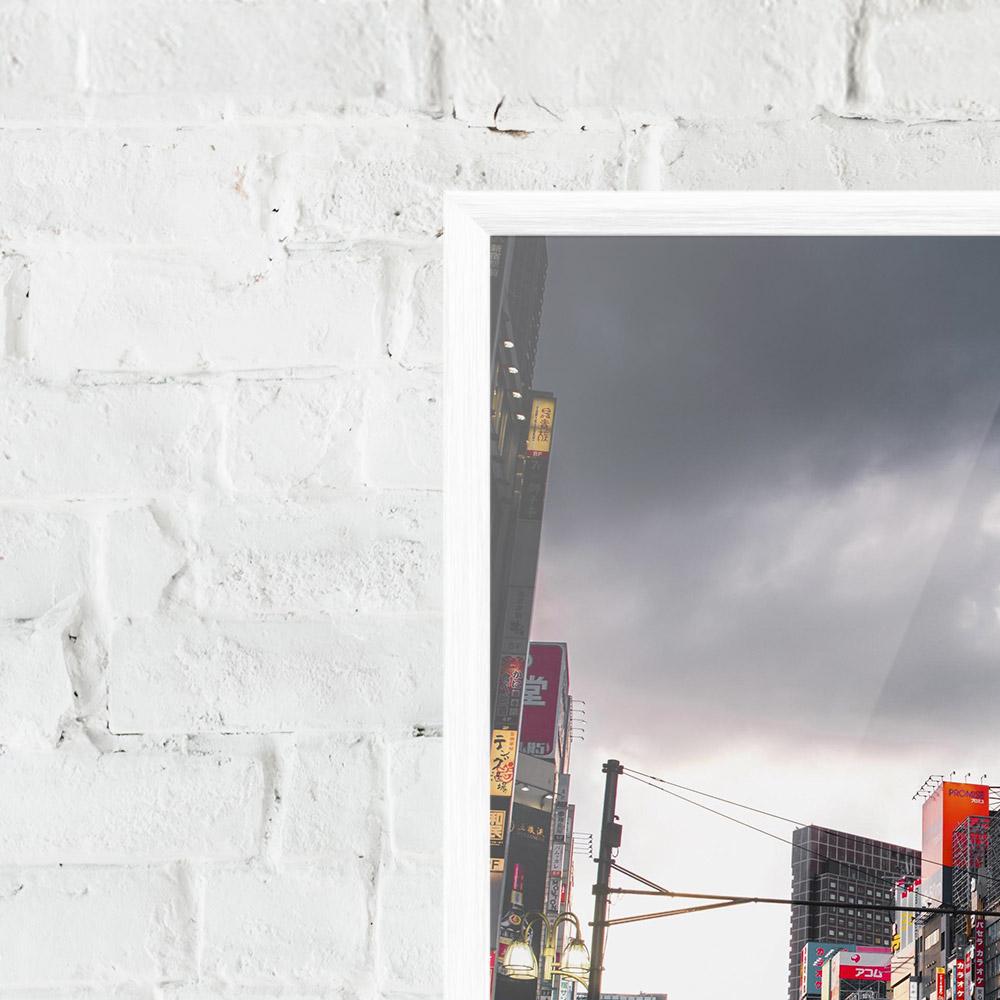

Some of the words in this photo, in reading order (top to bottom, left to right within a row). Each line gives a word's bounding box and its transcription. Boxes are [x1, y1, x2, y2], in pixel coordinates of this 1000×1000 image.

[948, 788, 984, 799] PROMISE
[976, 921, 984, 946] パセラ
[855, 968, 882, 979] アコム
[957, 962, 965, 997] カラオケ
[976, 950, 985, 984] カラオケ
